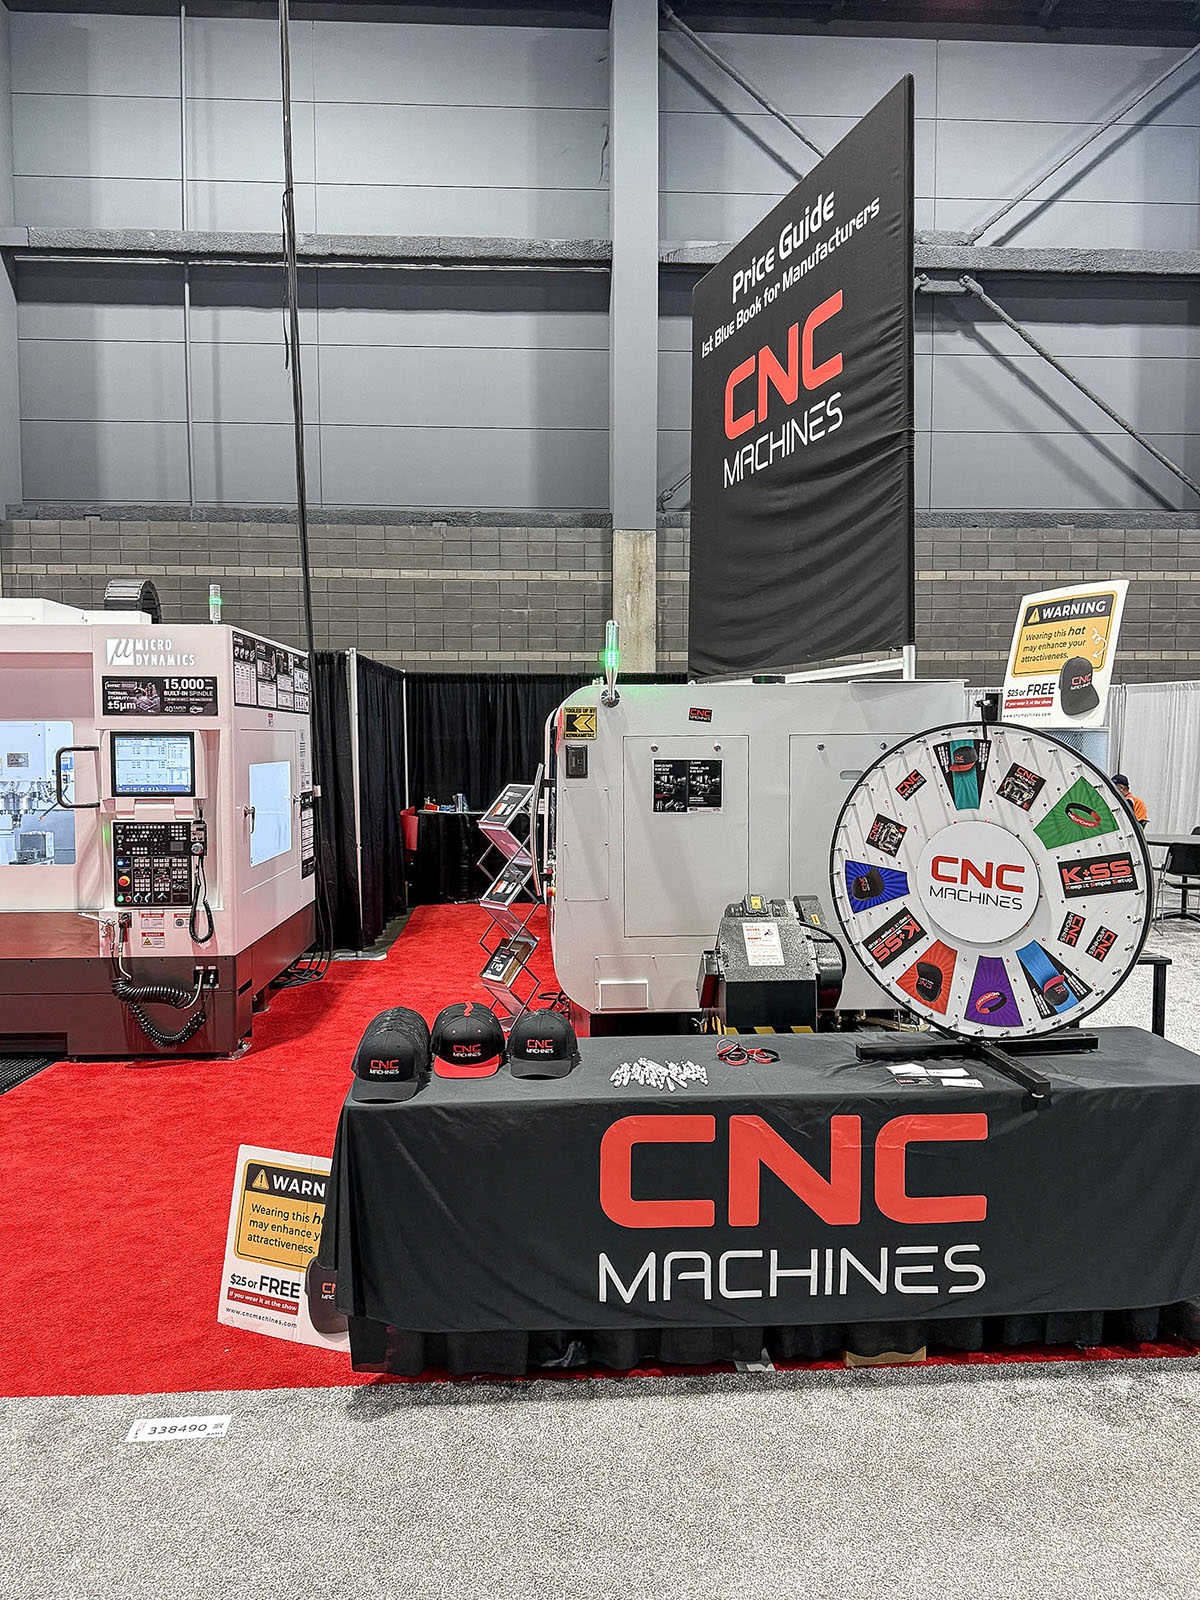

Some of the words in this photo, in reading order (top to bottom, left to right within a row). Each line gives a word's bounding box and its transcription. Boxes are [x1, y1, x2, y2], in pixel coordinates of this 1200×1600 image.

[732, 247, 775, 304] Price
[779, 191, 835, 260] Guide
[715, 320, 735, 348] Blue
[736, 295, 761, 330] Book
[763, 282, 781, 307] for
[782, 197, 880, 292] Manufacturers
[724, 289, 843, 439] CNC
[723, 391, 844, 489] MACHINES
[1042, 601, 1106, 620] WARNING
[1025, 631, 1053, 642] Wearing
[1054, 630, 1066, 638] this
[1067, 626, 1086, 635] hat
[135, 639, 172, 651] MICRO
[1023, 645, 1038, 653] may
[1038, 641, 1067, 651] enhance
[1068, 640, 1086, 650] your
[135, 654, 195, 666] DYNAMICS
[1021, 652, 1069, 663] attractiveness.
[163, 678, 204, 690] 15,000
[1007, 689, 1018, 697] $25
[1026, 682, 1056, 697] FREE
[1071, 673, 1092, 686] CNC
[690, 708, 711, 717] CNC
[897, 771, 921, 795] CNC
[1016, 767, 1039, 783] CNC
[869, 820, 881, 840] CNC
[931, 855, 1025, 893] CNC
[929, 885, 1023, 910] MACHINES
[1065, 916, 1083, 946] CNC
[1094, 931, 1116, 960] CNC
[453, 1044, 481, 1053] CNC
[526, 1040, 553, 1048] CNC
[370, 1060, 399, 1069] CNC
[600, 1113, 988, 1228] CNC
[251, 1203, 289, 1221] Wearing
[292, 1210, 310, 1223] this
[249, 1219, 269, 1231] may
[271, 1223, 311, 1239] enhance
[247, 1233, 315, 1255] attractiveness.
[598, 1243, 987, 1304] MACHINES
[230, 1273, 247, 1286] $25
[248, 1281, 257, 1289] or
[259, 1275, 301, 1299] FREE
[271, 1300, 281, 1308] the
[282, 1303, 297, 1311] show
[225, 1307, 297, 1328] www.cncmachines.com
[147, 1424, 207, 1435] 338490
